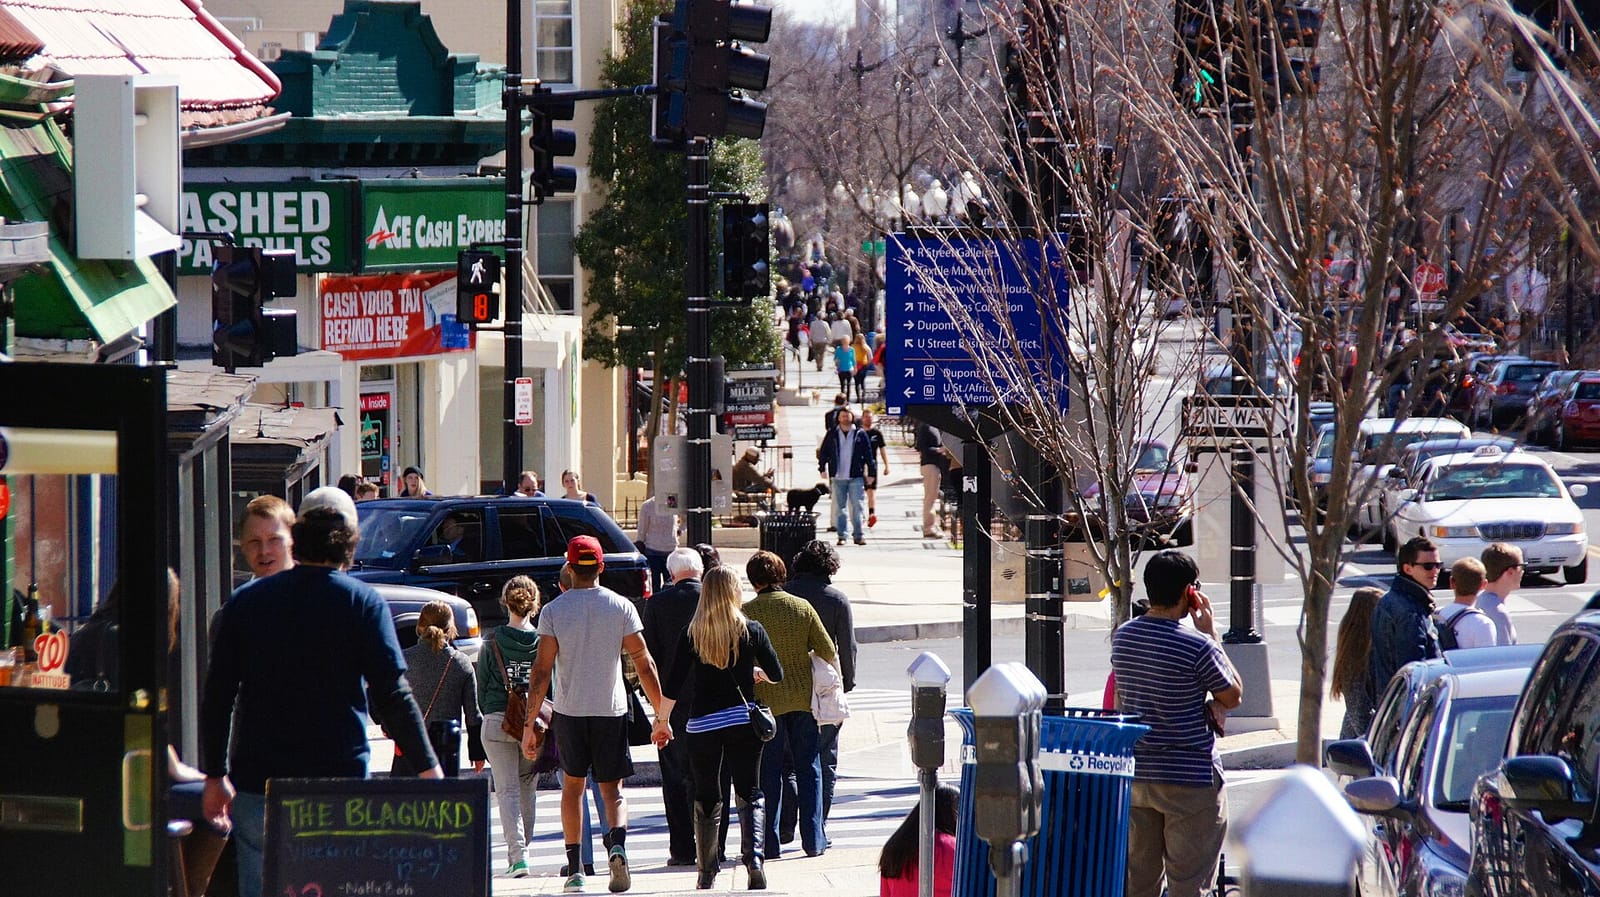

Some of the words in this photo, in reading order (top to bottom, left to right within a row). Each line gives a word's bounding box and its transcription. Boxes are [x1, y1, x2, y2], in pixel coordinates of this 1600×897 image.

[366, 205, 411, 249] ACE
[415, 215, 453, 248] CASH
[177, 239, 226, 267] PA
[917, 248, 924, 257] R
[927, 248, 955, 257] Street
[917, 284, 963, 294] Woow
[324, 292, 358, 318] CASH
[359, 290, 394, 317] YOUR
[398, 286, 421, 314] TAX
[917, 302, 936, 312] The
[974, 302, 1024, 312] Colcion
[325, 317, 374, 345] REFUND
[376, 315, 409, 341] HERE
[917, 320, 955, 333] Dupont
[917, 338, 925, 349] U
[927, 338, 956, 349] Street
[958, 338, 999, 349] Bsies
[1002, 338, 1037, 349] Dtrict
[943, 368, 980, 379] Dupont
[982, 368, 1009, 378] Circ
[729, 386, 766, 398] MILLER
[943, 383, 950, 393] U
[368, 396, 387, 408] Inside
[33, 675, 67, 688] NATITUDE
[282, 799, 333, 830] THE
[345, 799, 474, 830] BLAGUARD
